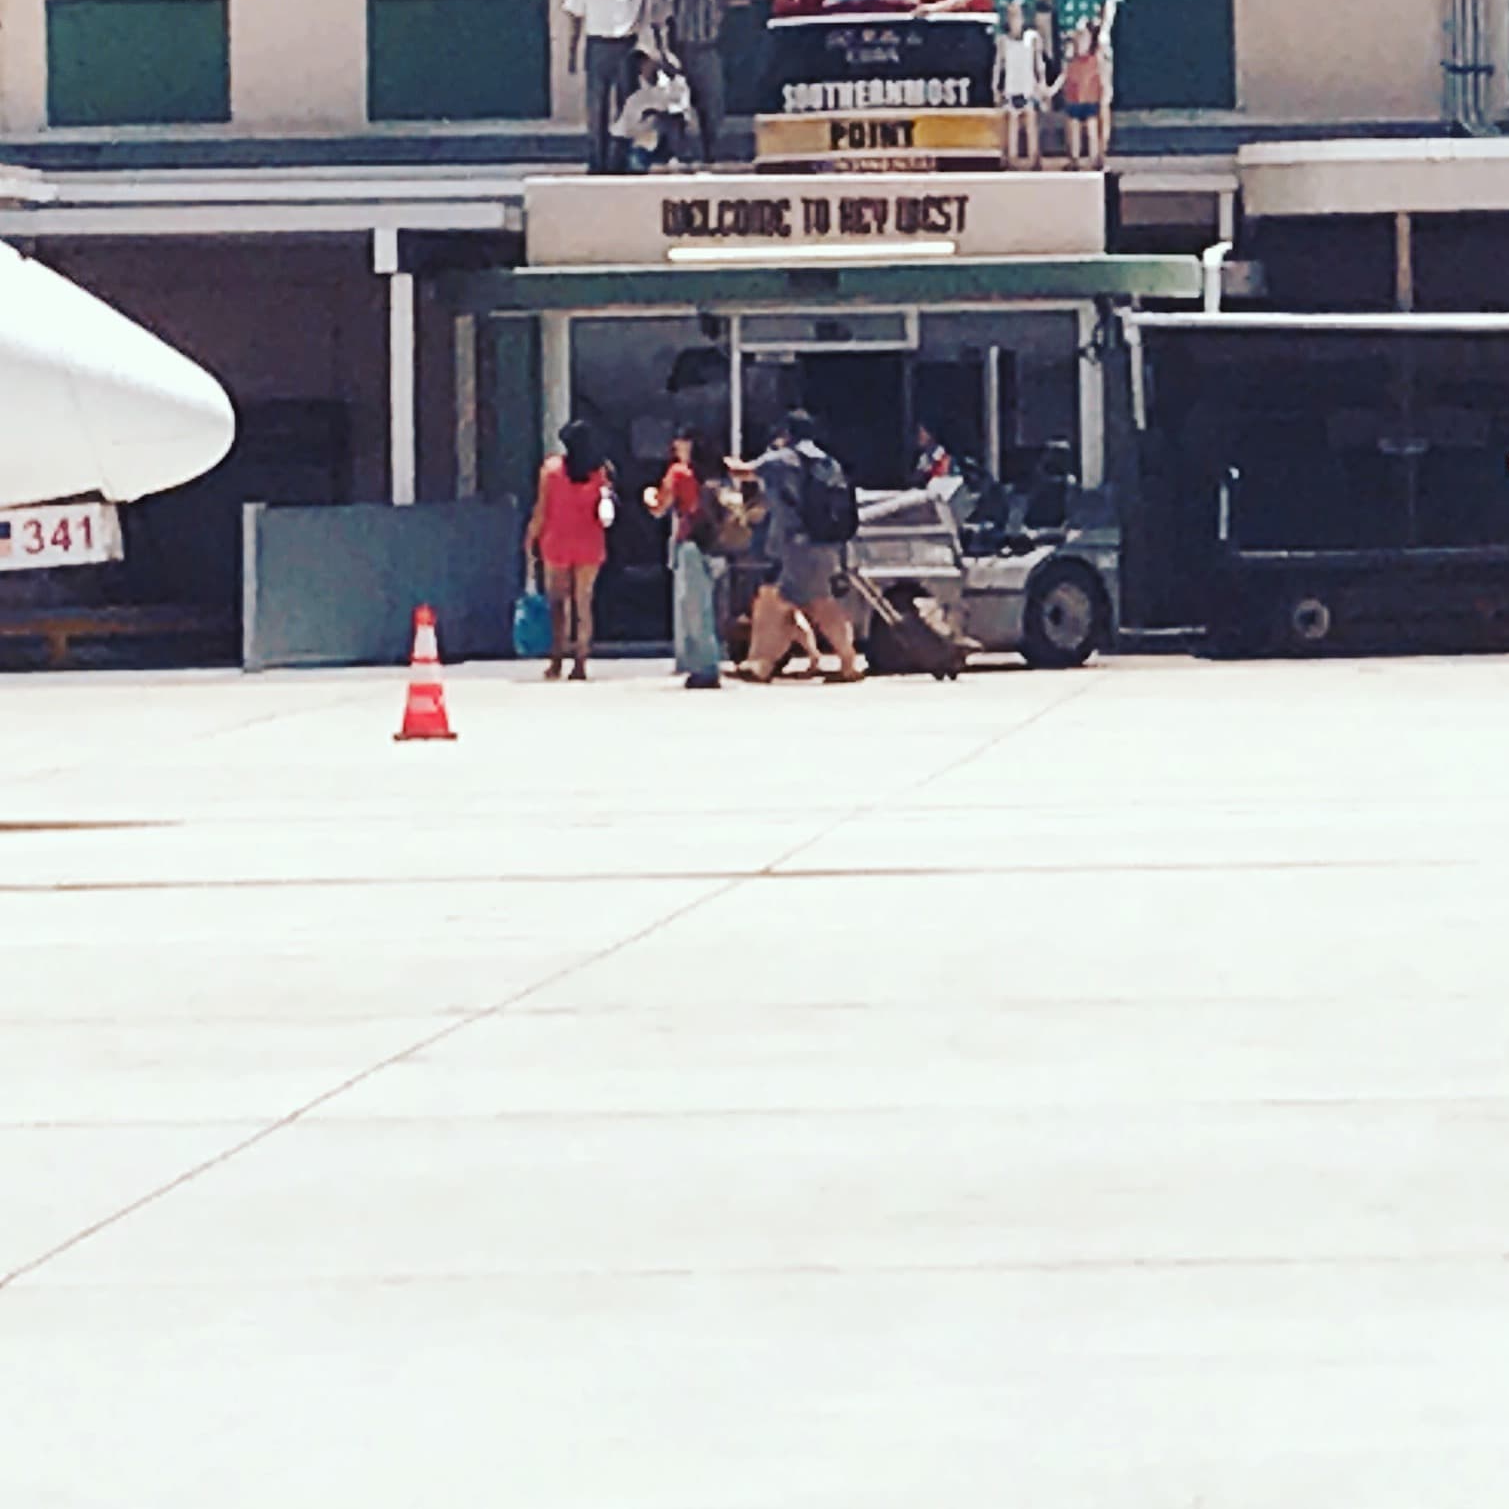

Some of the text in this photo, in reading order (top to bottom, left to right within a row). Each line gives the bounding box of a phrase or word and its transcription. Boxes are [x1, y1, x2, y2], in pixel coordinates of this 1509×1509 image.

[782, 76, 971, 113] SOUTHERNMOST
[830, 119, 916, 151] POINT
[662, 193, 969, 238] WELCOME TO KEY WEST
[23, 515, 93, 555] 341
